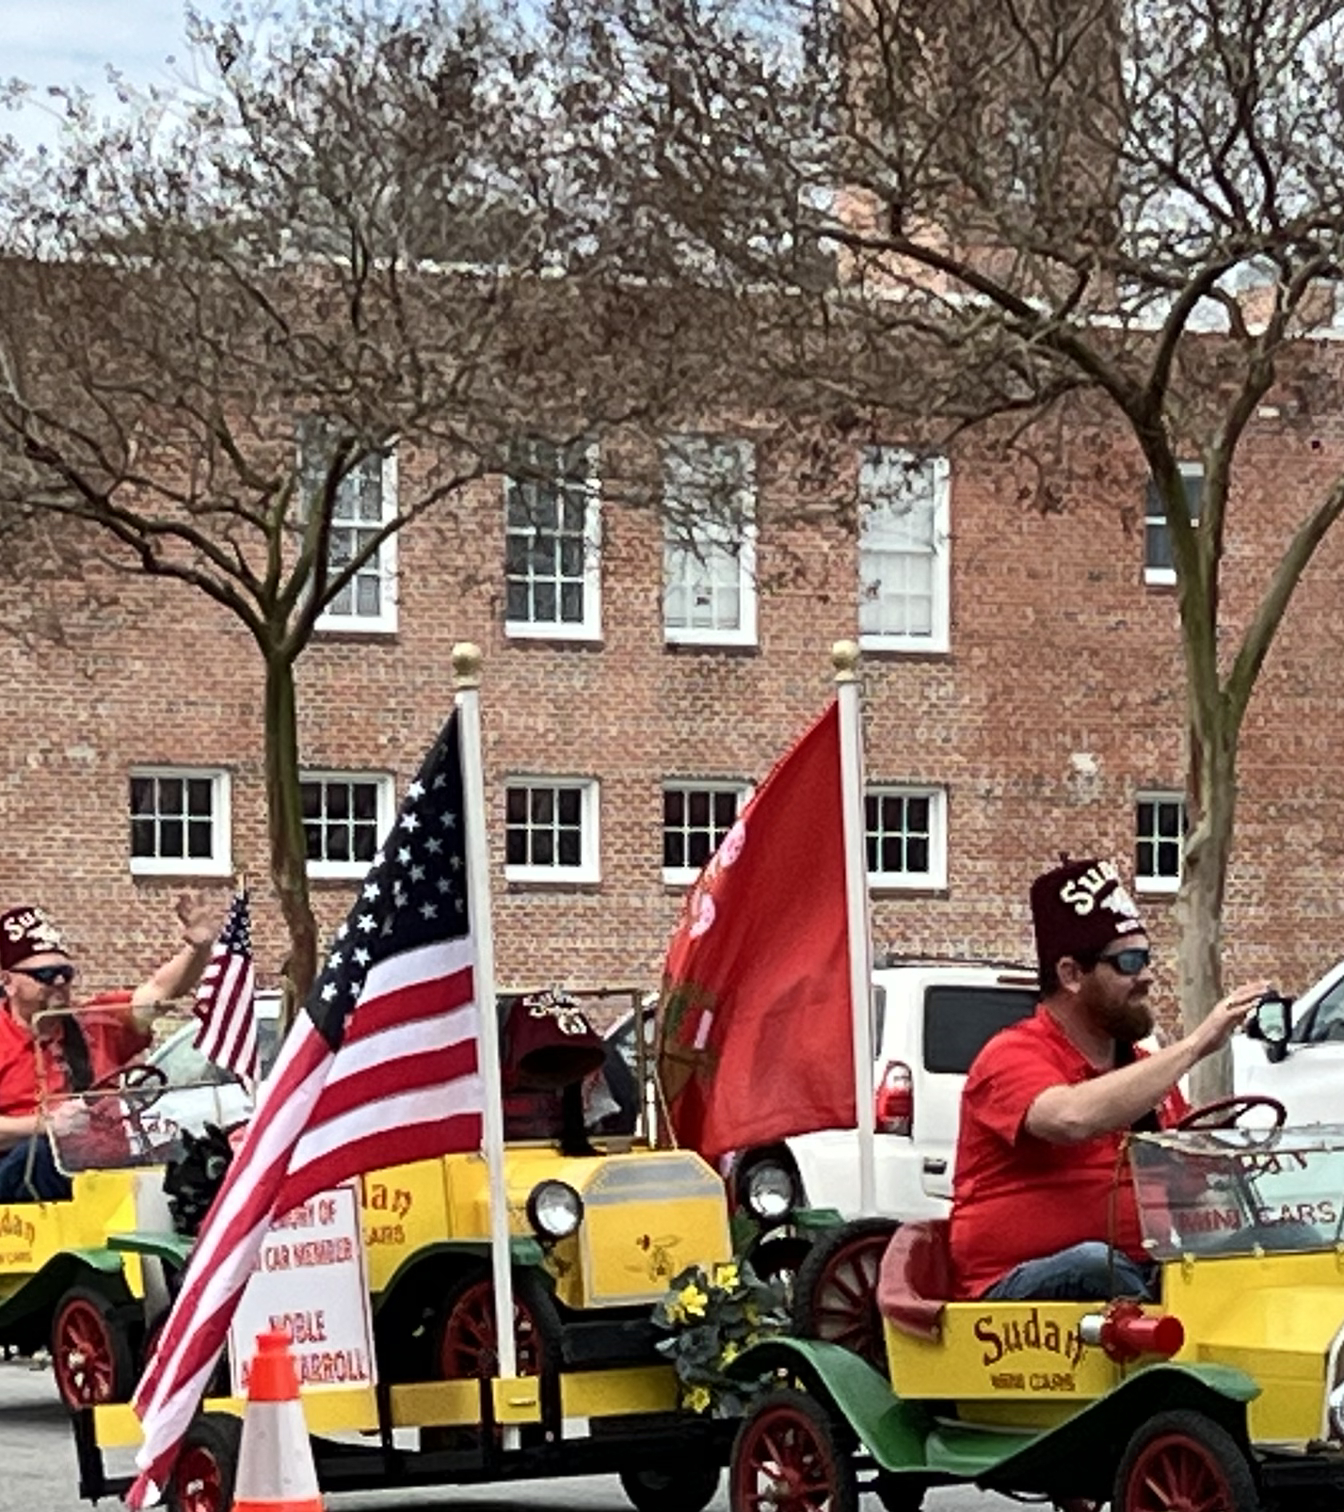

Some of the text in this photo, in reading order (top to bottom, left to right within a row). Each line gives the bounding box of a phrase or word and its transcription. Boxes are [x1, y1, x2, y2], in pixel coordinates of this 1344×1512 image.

[318, 1199, 337, 1226] OF
[1257, 1201, 1337, 1228] CARS
[265, 1244, 291, 1273] CAR
[973, 1307, 1083, 1370] Sudan
[294, 1348, 368, 1386] ARROLL
